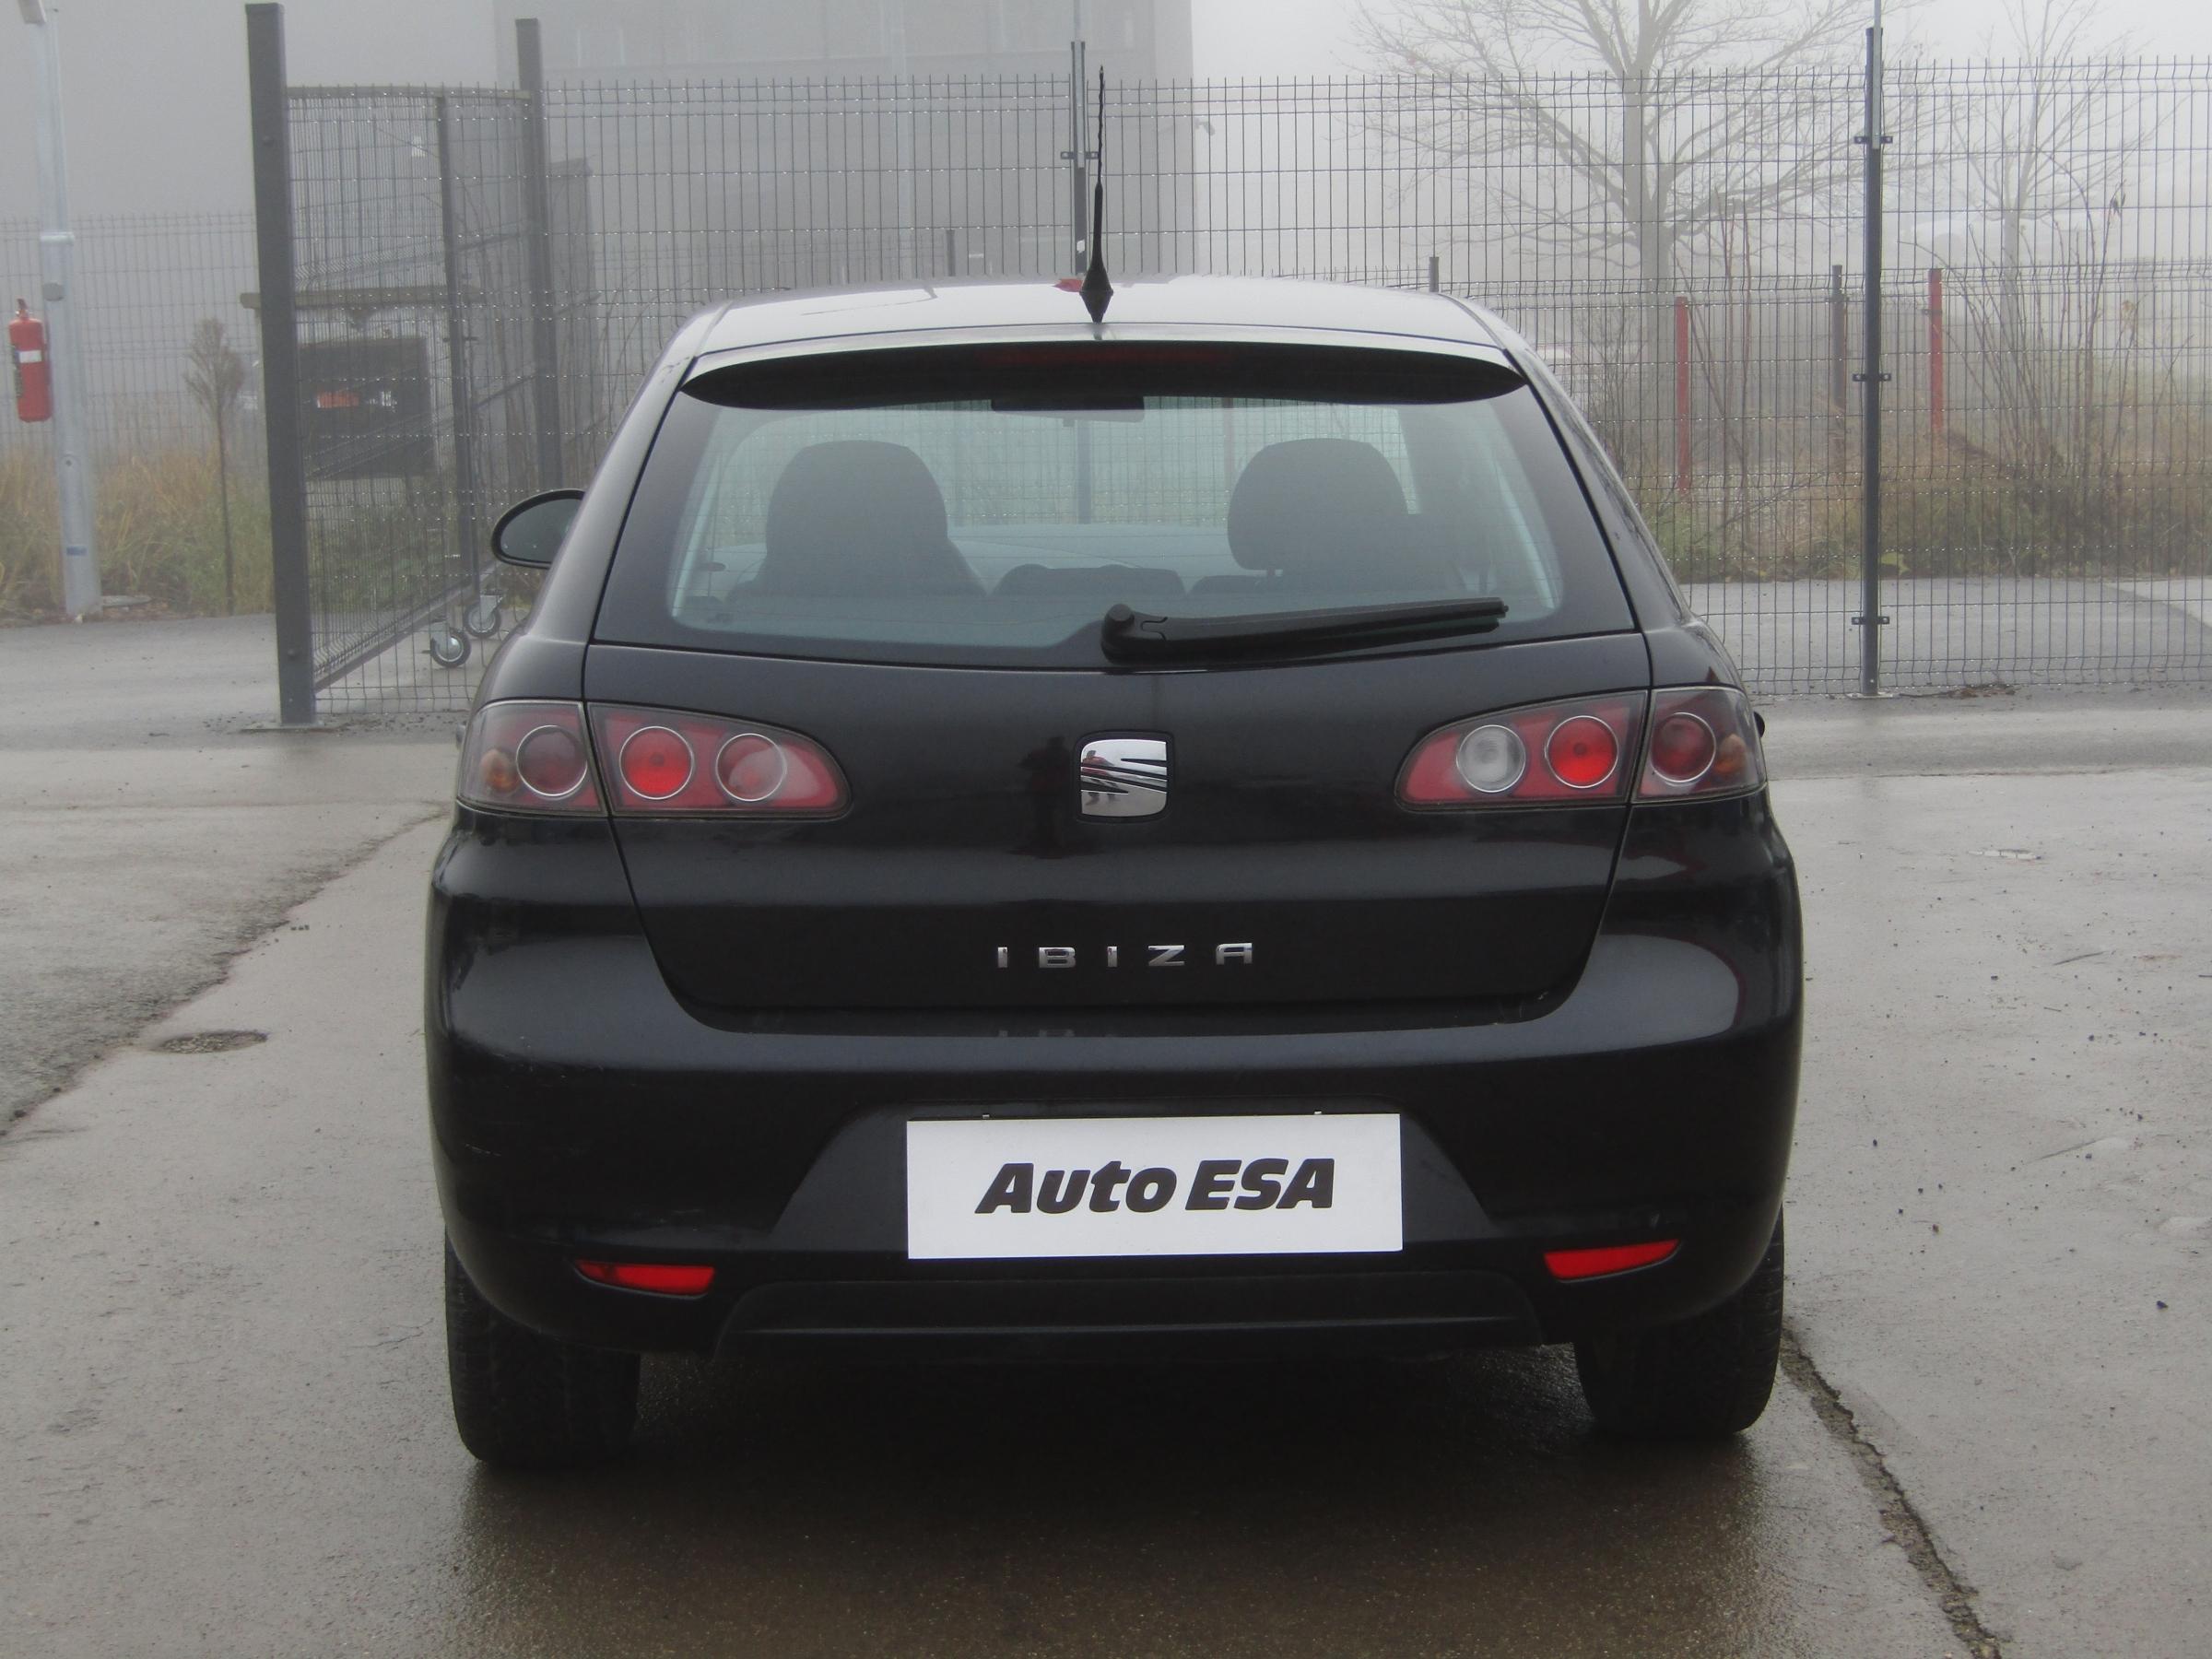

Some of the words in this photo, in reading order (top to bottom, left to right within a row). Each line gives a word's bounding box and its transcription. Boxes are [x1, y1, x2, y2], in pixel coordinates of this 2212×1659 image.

[996, 942, 1253, 968] IBIZA
[974, 1161, 1177, 1214] Auto
[1184, 1159, 1335, 1211] ESA
